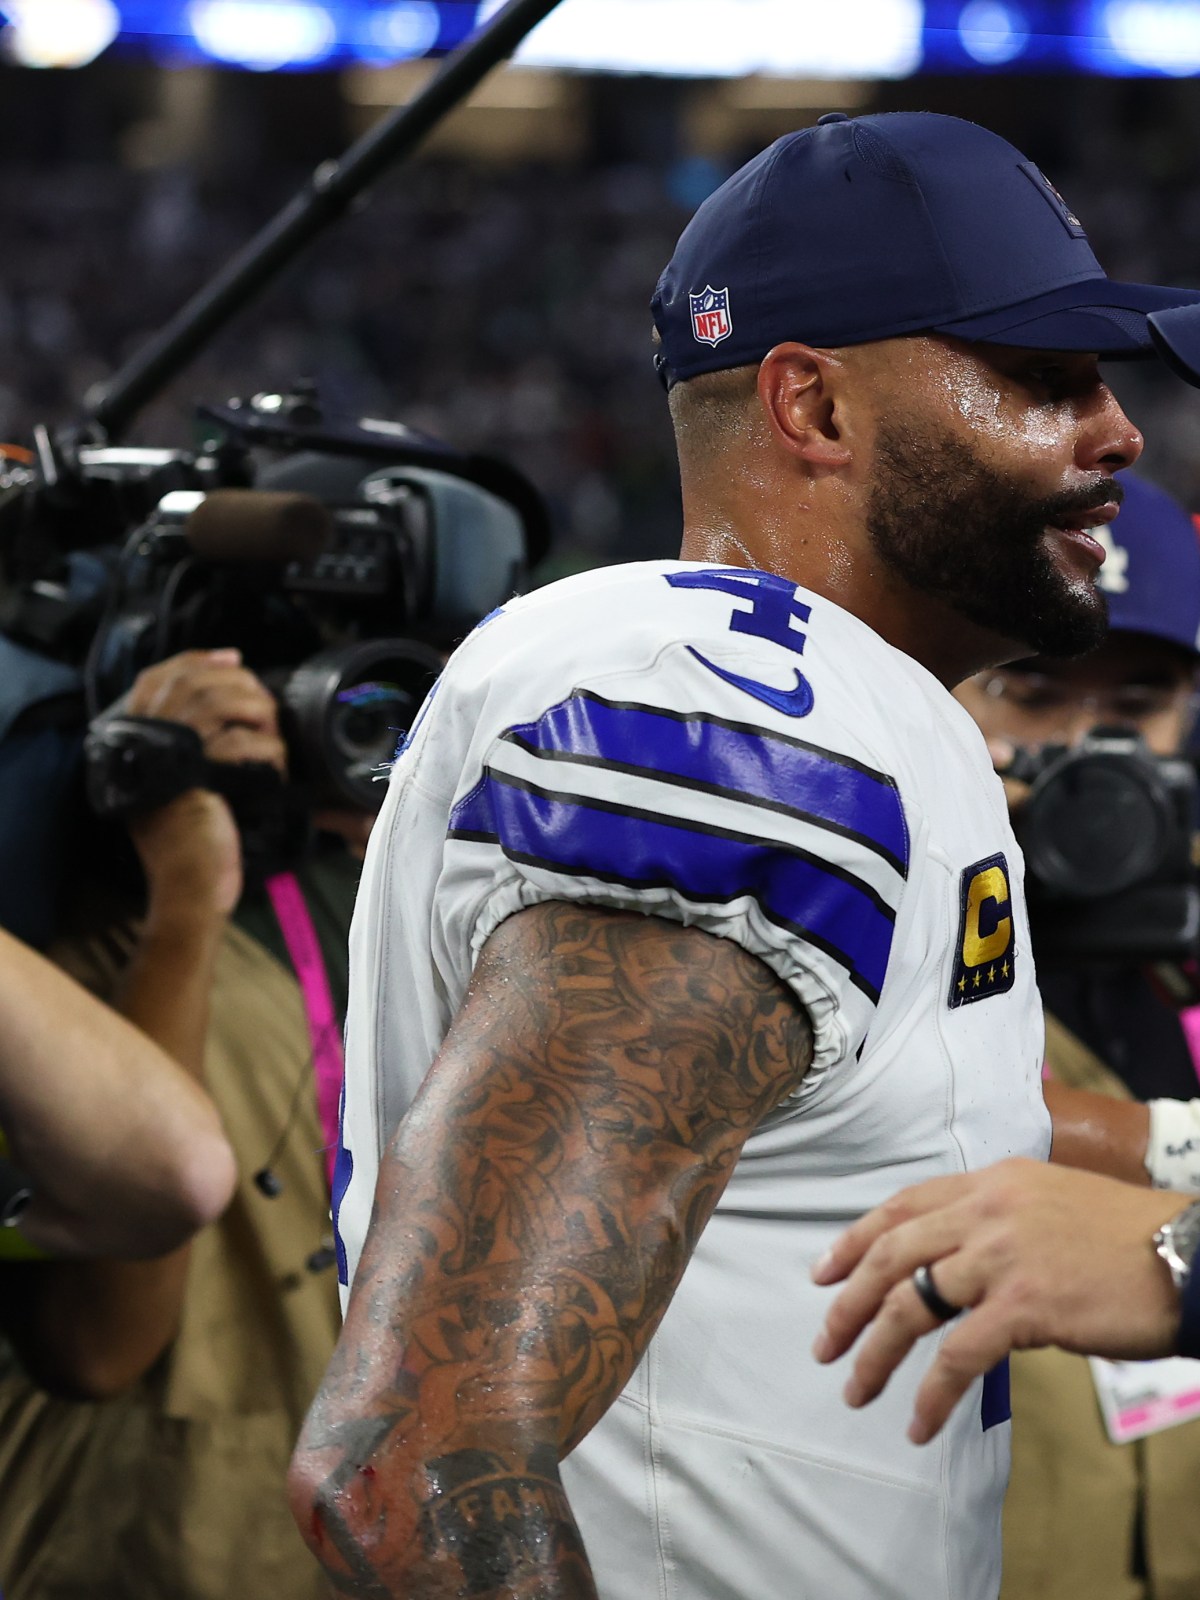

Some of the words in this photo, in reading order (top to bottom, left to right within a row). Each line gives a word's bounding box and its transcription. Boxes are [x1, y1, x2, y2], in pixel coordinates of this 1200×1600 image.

[694, 311, 728, 339] NFL
[660, 568, 812, 656] 4
[962, 866, 1012, 959] C
